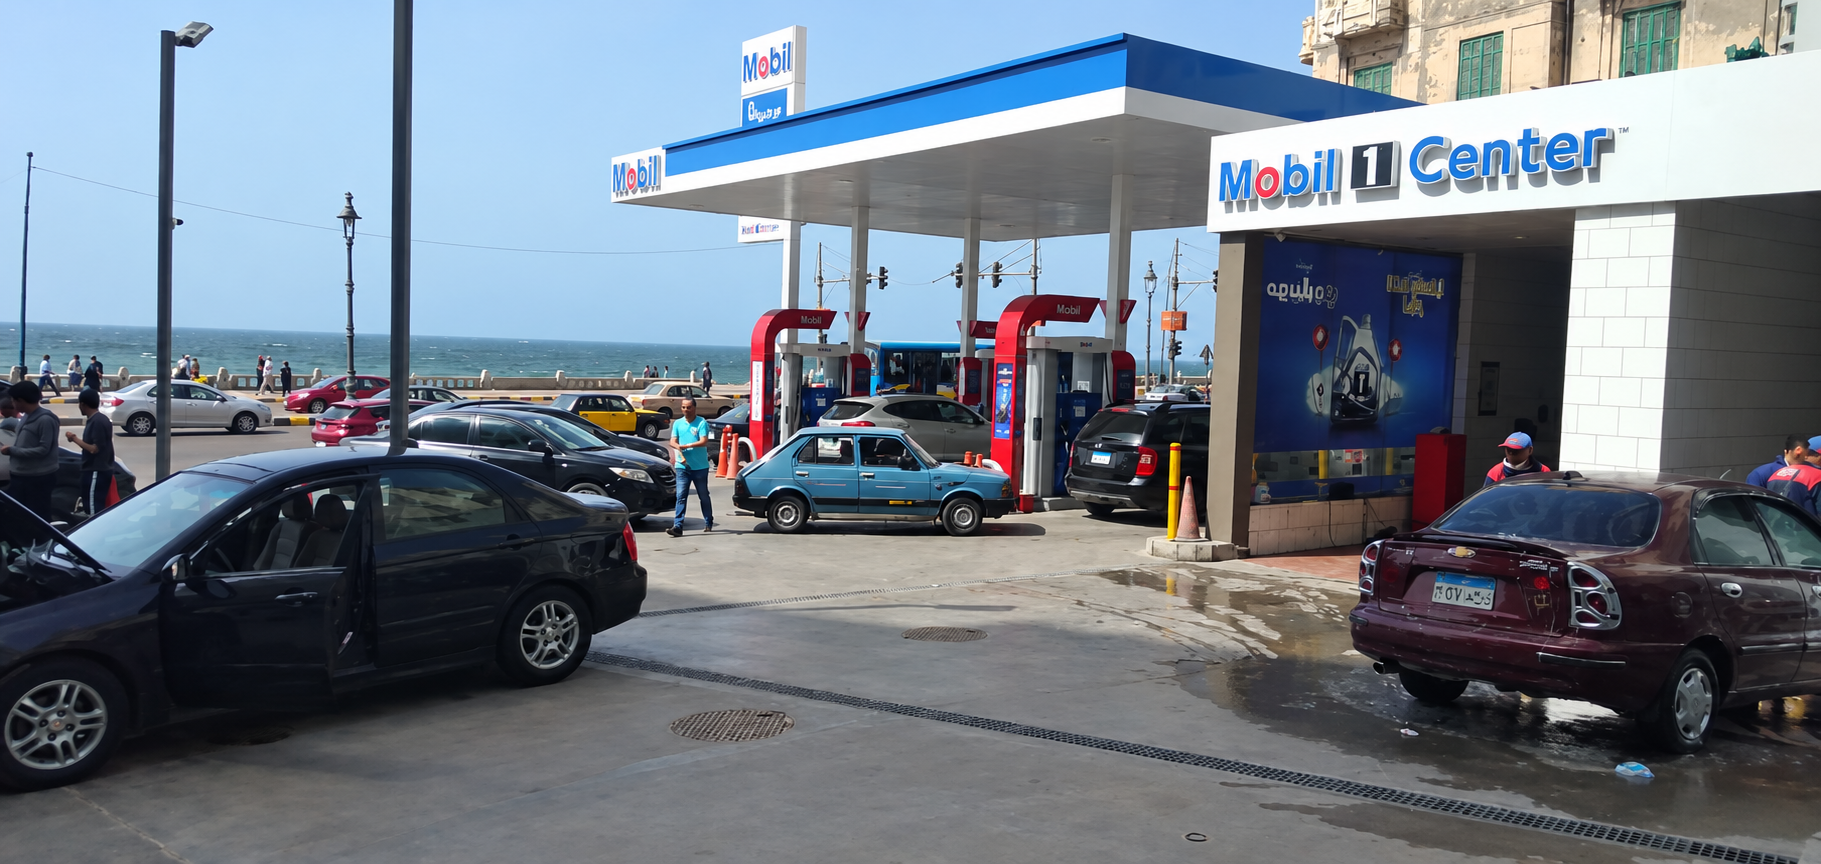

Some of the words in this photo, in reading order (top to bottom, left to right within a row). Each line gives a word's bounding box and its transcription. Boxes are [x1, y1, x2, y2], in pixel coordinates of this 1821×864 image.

[743, 41, 792, 82] Mobil
[612, 155, 659, 193] Mobil
[1219, 148, 1340, 202] Mobil
[1409, 127, 1612, 184] Center
[800, 315, 822, 324] Mobil
[1056, 303, 1081, 315] Mobil
